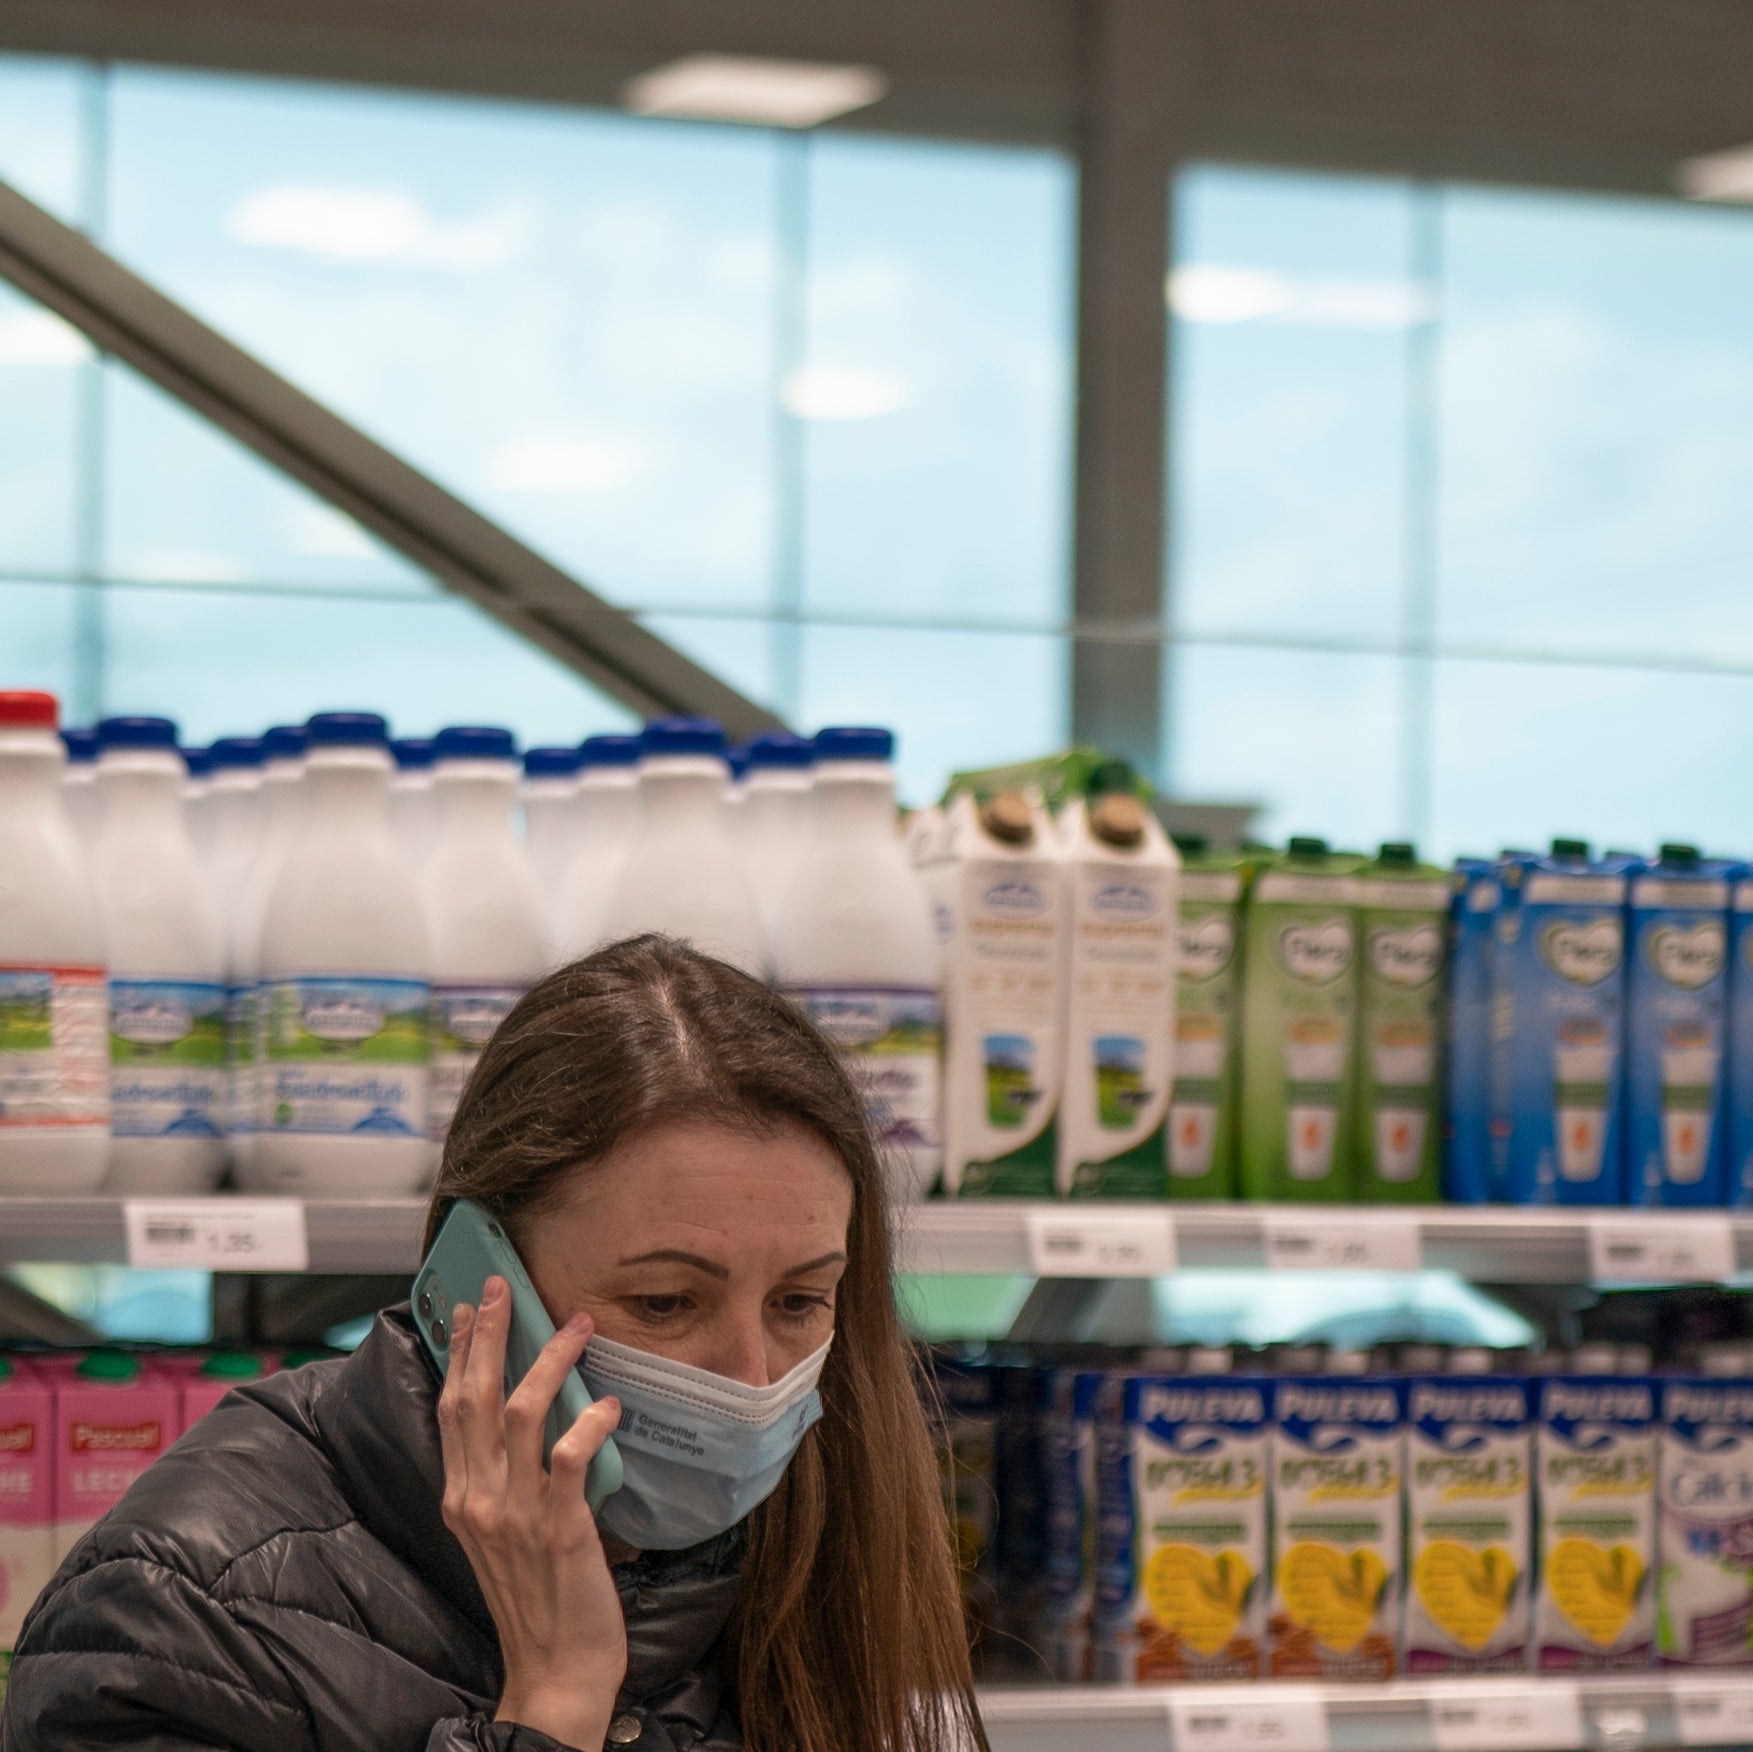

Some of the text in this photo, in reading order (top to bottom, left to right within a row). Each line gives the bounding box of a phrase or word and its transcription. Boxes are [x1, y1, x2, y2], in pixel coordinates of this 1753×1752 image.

[74, 1423, 159, 1451] Pascual
[639, 1414, 698, 1441] Generalitat
[635, 1427, 705, 1457] de Catalunya
[72, 1469, 138, 1494] LEC
